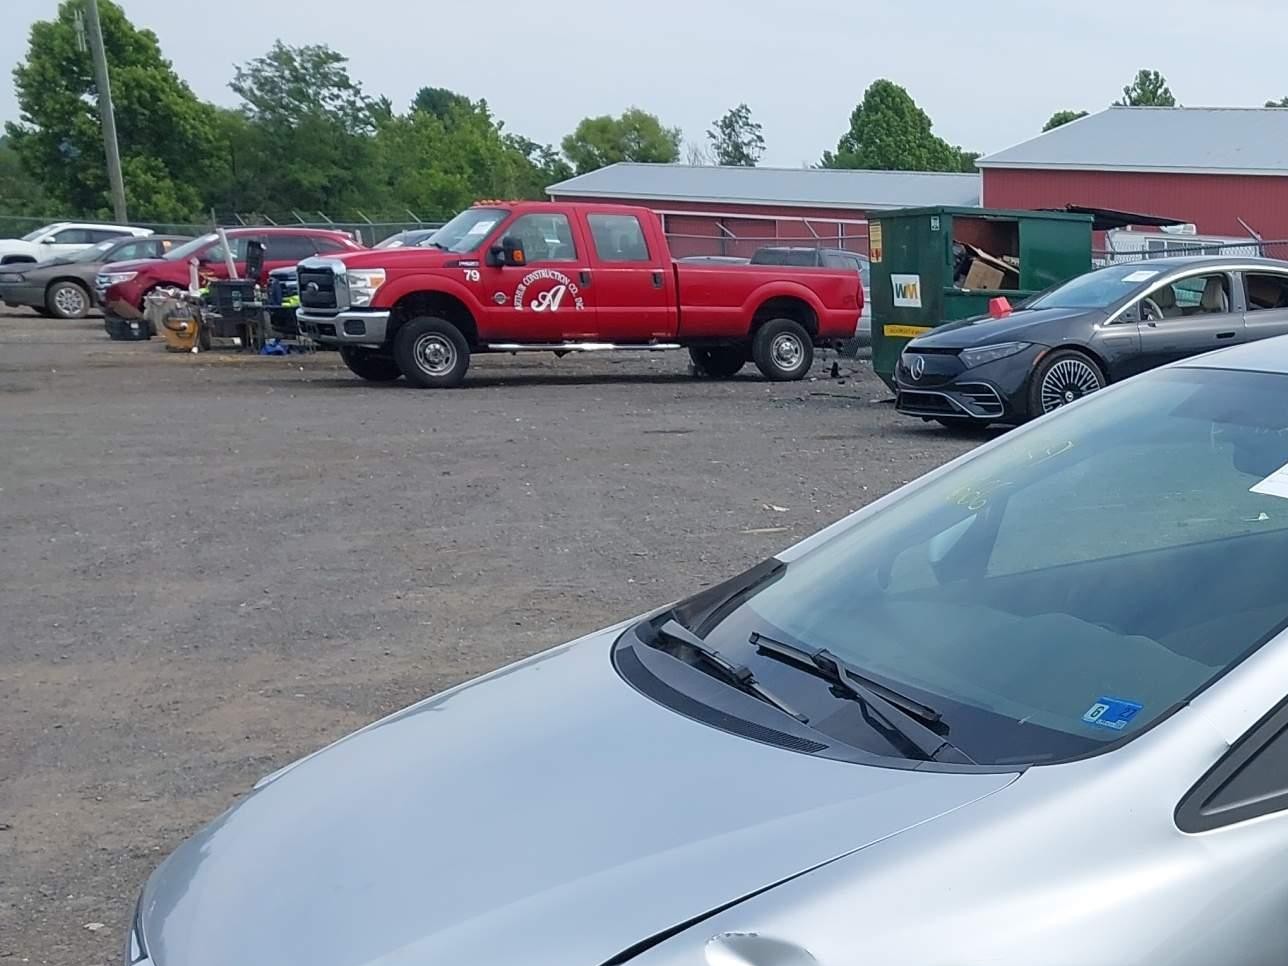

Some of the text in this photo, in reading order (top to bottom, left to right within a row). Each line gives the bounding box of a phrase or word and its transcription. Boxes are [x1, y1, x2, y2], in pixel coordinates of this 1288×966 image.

[463, 269, 480, 282] 79
[522, 268, 571, 287] CONSTRUCTION
[530, 284, 567, 312] A
[895, 283, 918, 299] WM
[1091, 706, 1104, 717] 6
